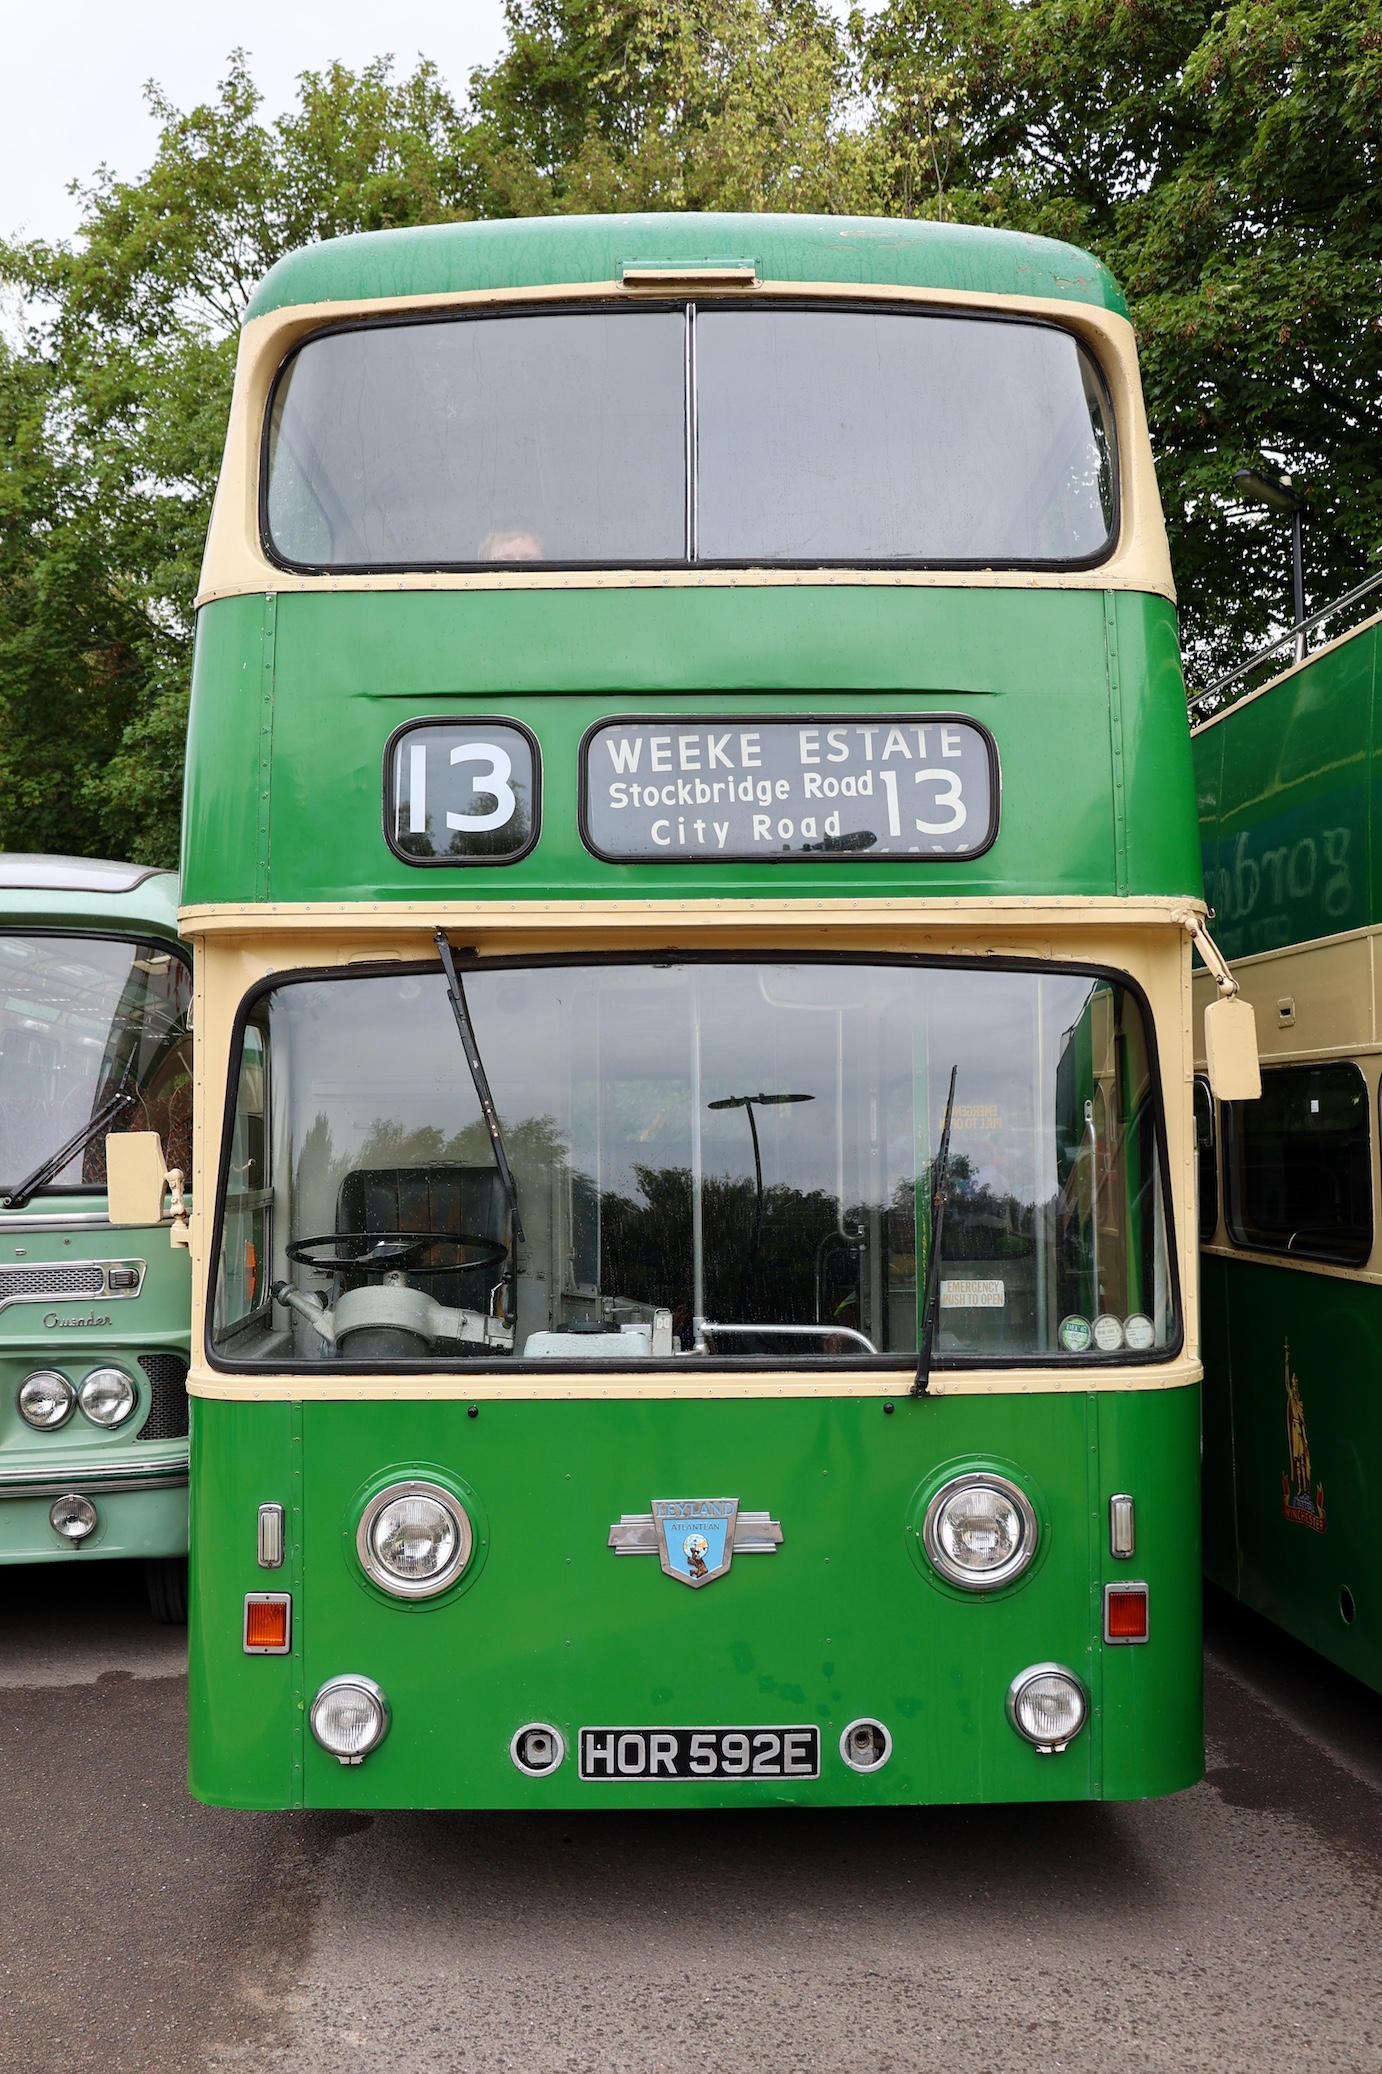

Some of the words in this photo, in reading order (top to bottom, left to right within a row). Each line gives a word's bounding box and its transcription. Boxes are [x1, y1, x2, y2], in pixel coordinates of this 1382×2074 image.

[606, 733, 762, 774] WEEKE
[799, 725, 962, 764] ESTATE
[408, 742, 517, 834] 13
[609, 775, 790, 809] Stockbridge
[803, 769, 873, 799] Road
[879, 768, 967, 837] 13
[651, 817, 730, 849] City
[752, 810, 841, 841] Road
[942, 1293, 966, 1306] PUSH
[967, 1293, 979, 1305] TO
[981, 1293, 1004, 1305] OPEN
[947, 1281, 999, 1293] EMERGENCY
[43, 1310, 113, 1329] Crusader
[656, 1501, 736, 1518] LEYLAND
[1285, 1508, 1324, 1531] WINCHESTER
[671, 1522, 720, 1531] ATLANTEAN
[586, 1733, 679, 1775] HOR
[689, 1733, 812, 1774] 592E
